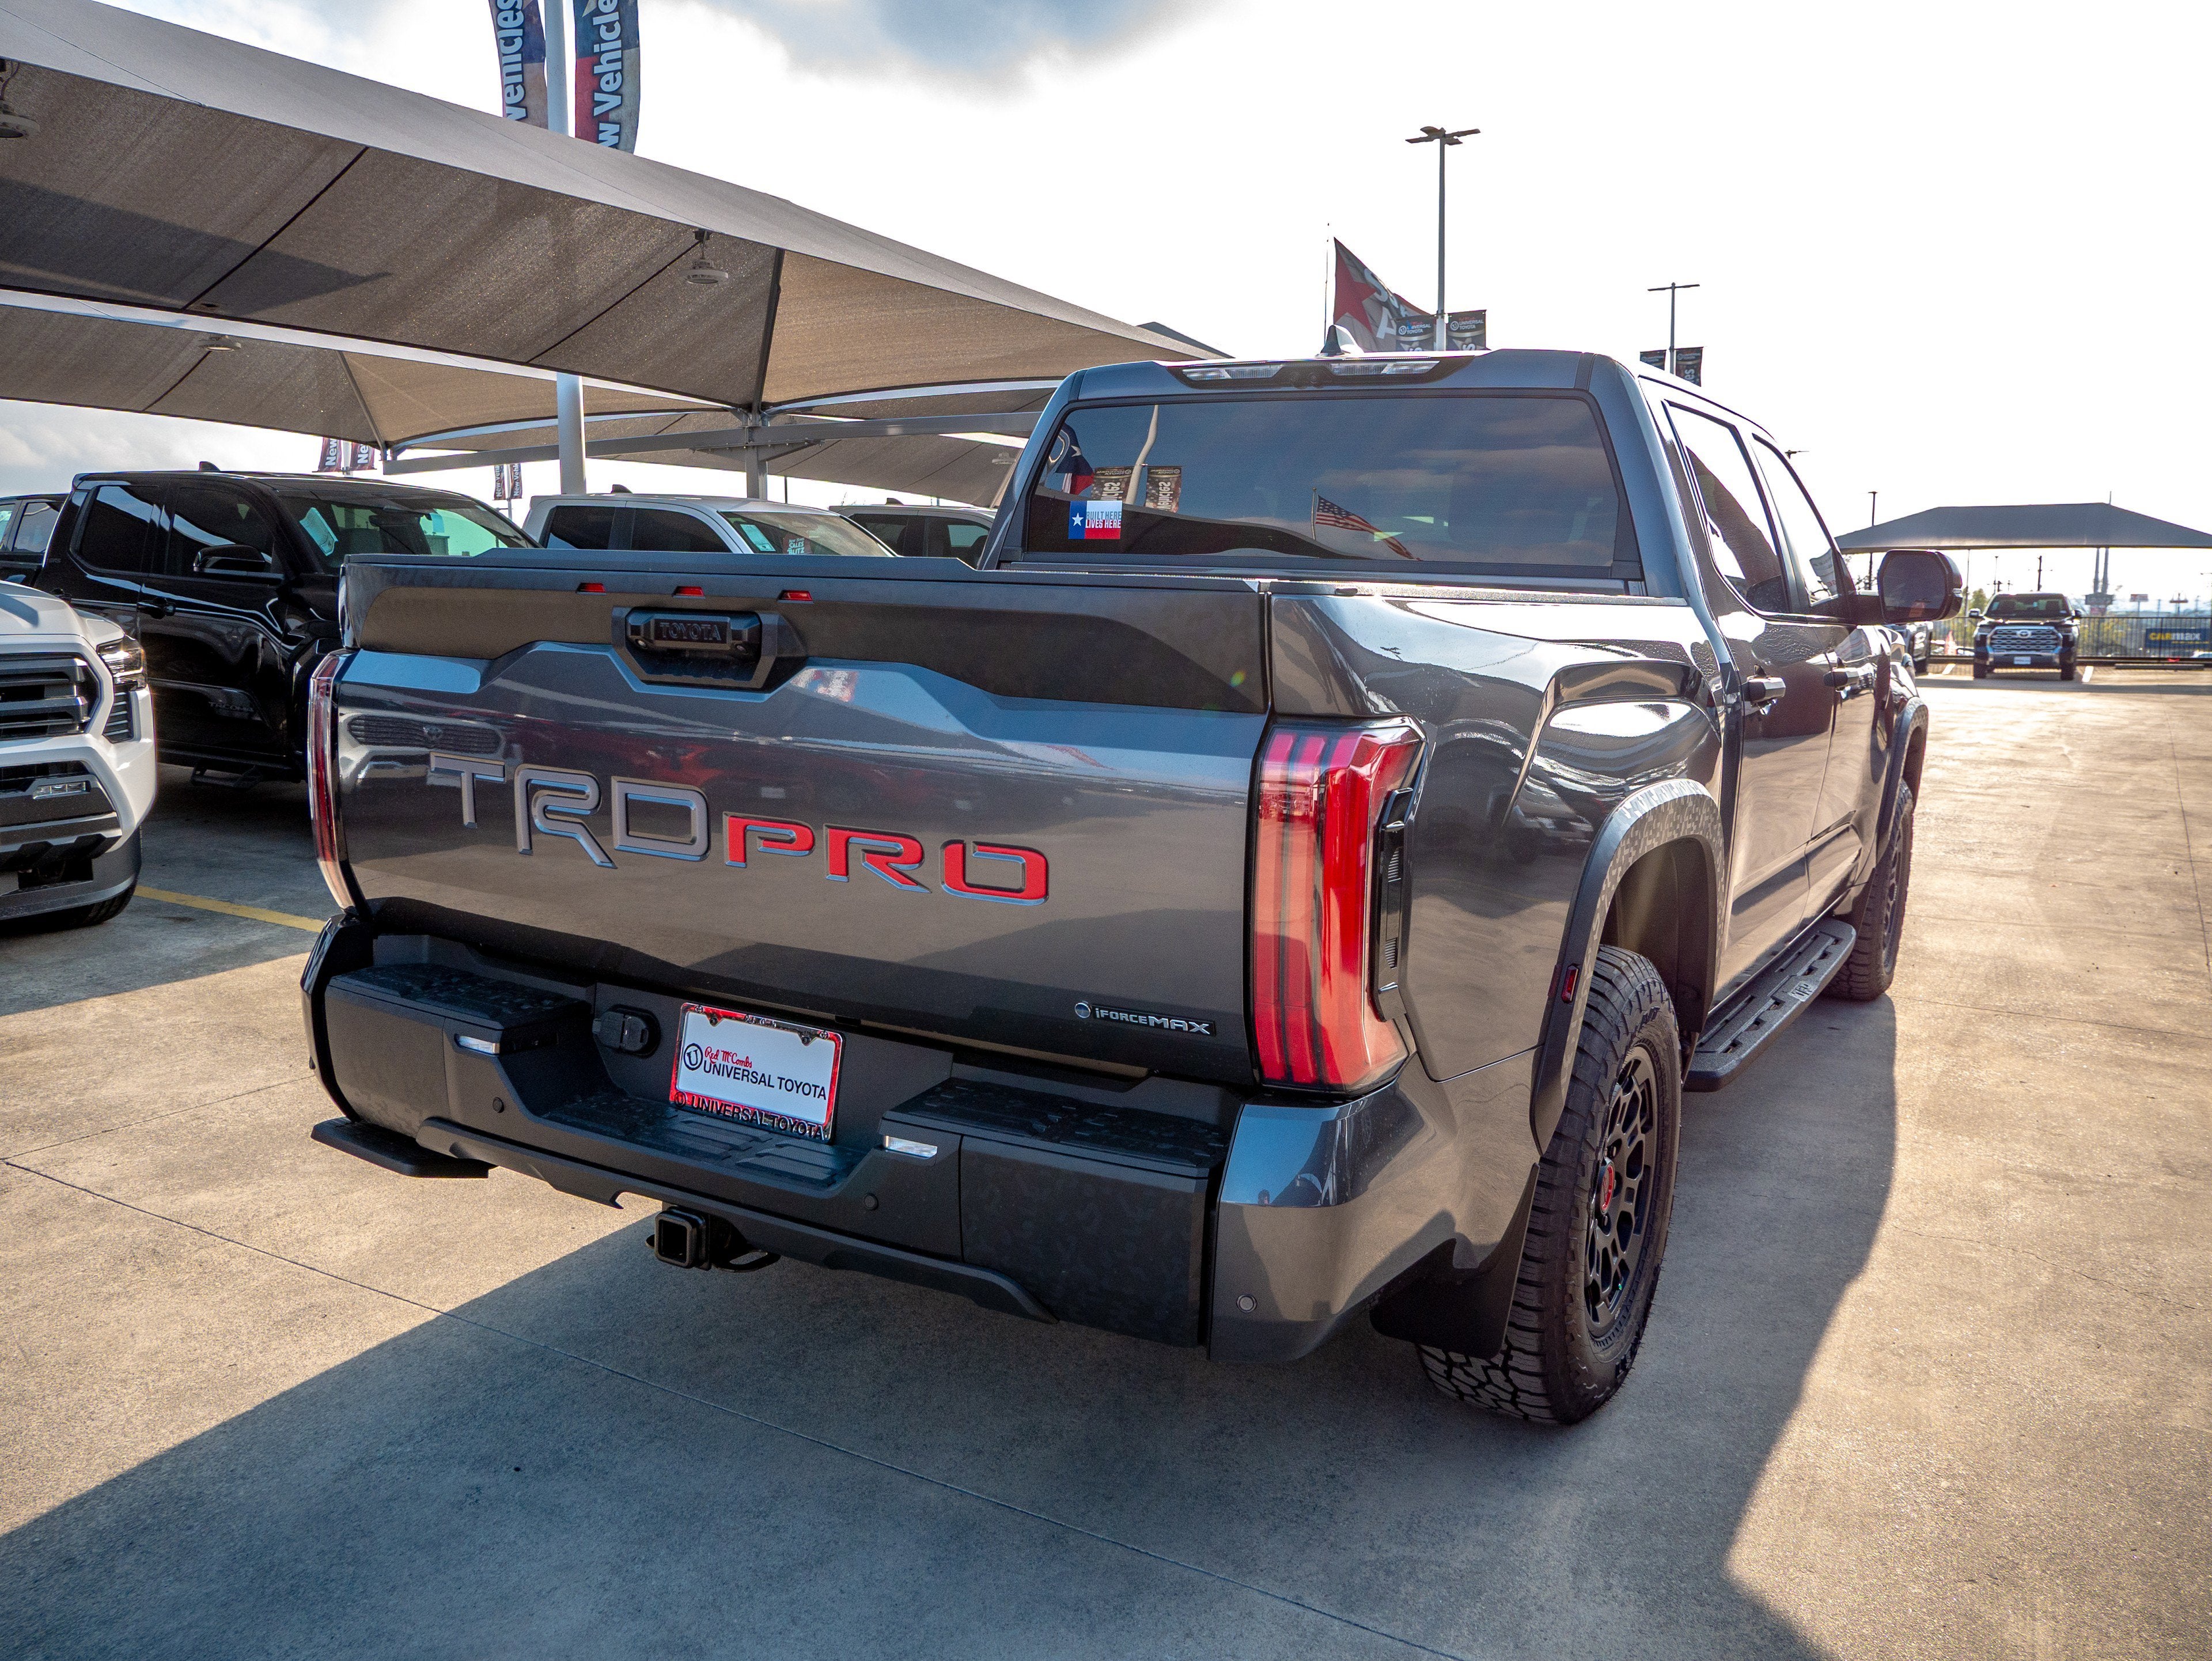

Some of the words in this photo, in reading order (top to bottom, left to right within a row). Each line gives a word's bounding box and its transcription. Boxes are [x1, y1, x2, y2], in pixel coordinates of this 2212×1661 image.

[325, 438, 337, 466] New
[357, 444, 369, 464] Ne
[1085, 520, 1104, 529] LIVES
[1104, 520, 1122, 529] HERE
[1086, 512, 1105, 520] BUILT
[1105, 512, 1122, 520] HERE
[659, 622, 721, 641] TOYOTA
[428, 752, 711, 869] TRD
[722, 810, 1050, 907] PRO
[704, 1046, 719, 1064] Red
[721, 1050, 752, 1069] McCombs
[703, 1060, 775, 1088] UNIVERSAL
[777, 1076, 827, 1100] TOYOTA
[691, 1095, 769, 1126] UNIVERSAL
[771, 1114, 825, 1141] TOYOTA
